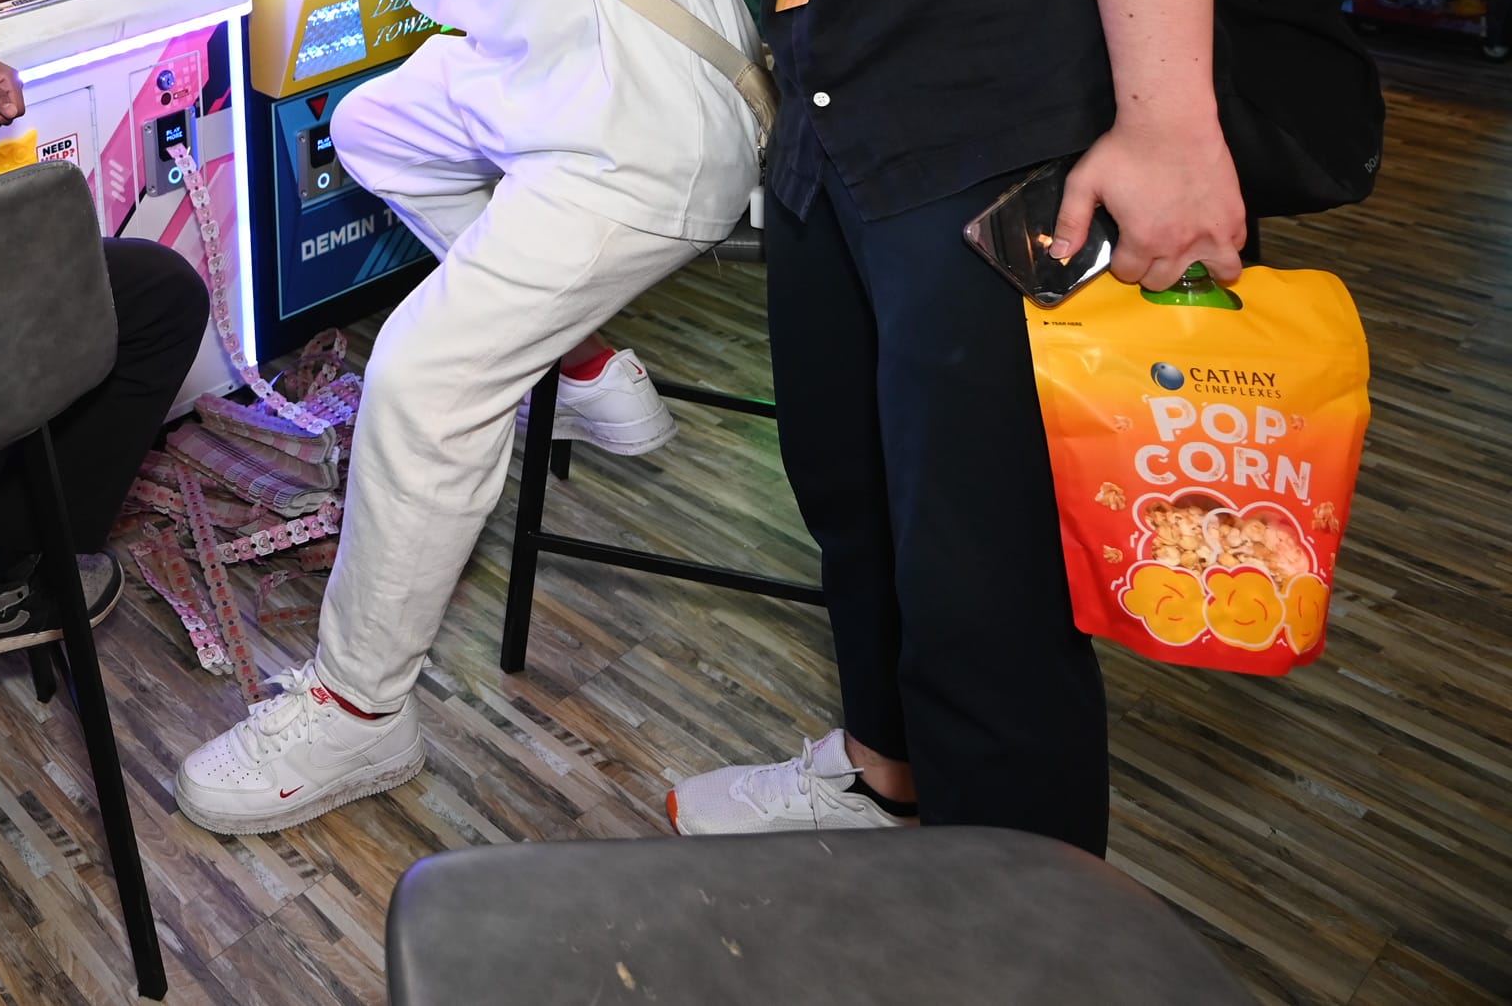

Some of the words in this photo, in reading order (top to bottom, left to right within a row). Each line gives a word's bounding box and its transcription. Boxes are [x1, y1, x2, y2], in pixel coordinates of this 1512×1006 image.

[373, 14, 436, 47] TOWE
[42, 139, 72, 157] NEED
[301, 214, 375, 262] DEMON
[1189, 367, 1276, 387] CATHAY
[1194, 384, 1282, 399] CINEPLEXES
[1148, 395, 1288, 444] POP
[1134, 441, 1312, 501] CORN
